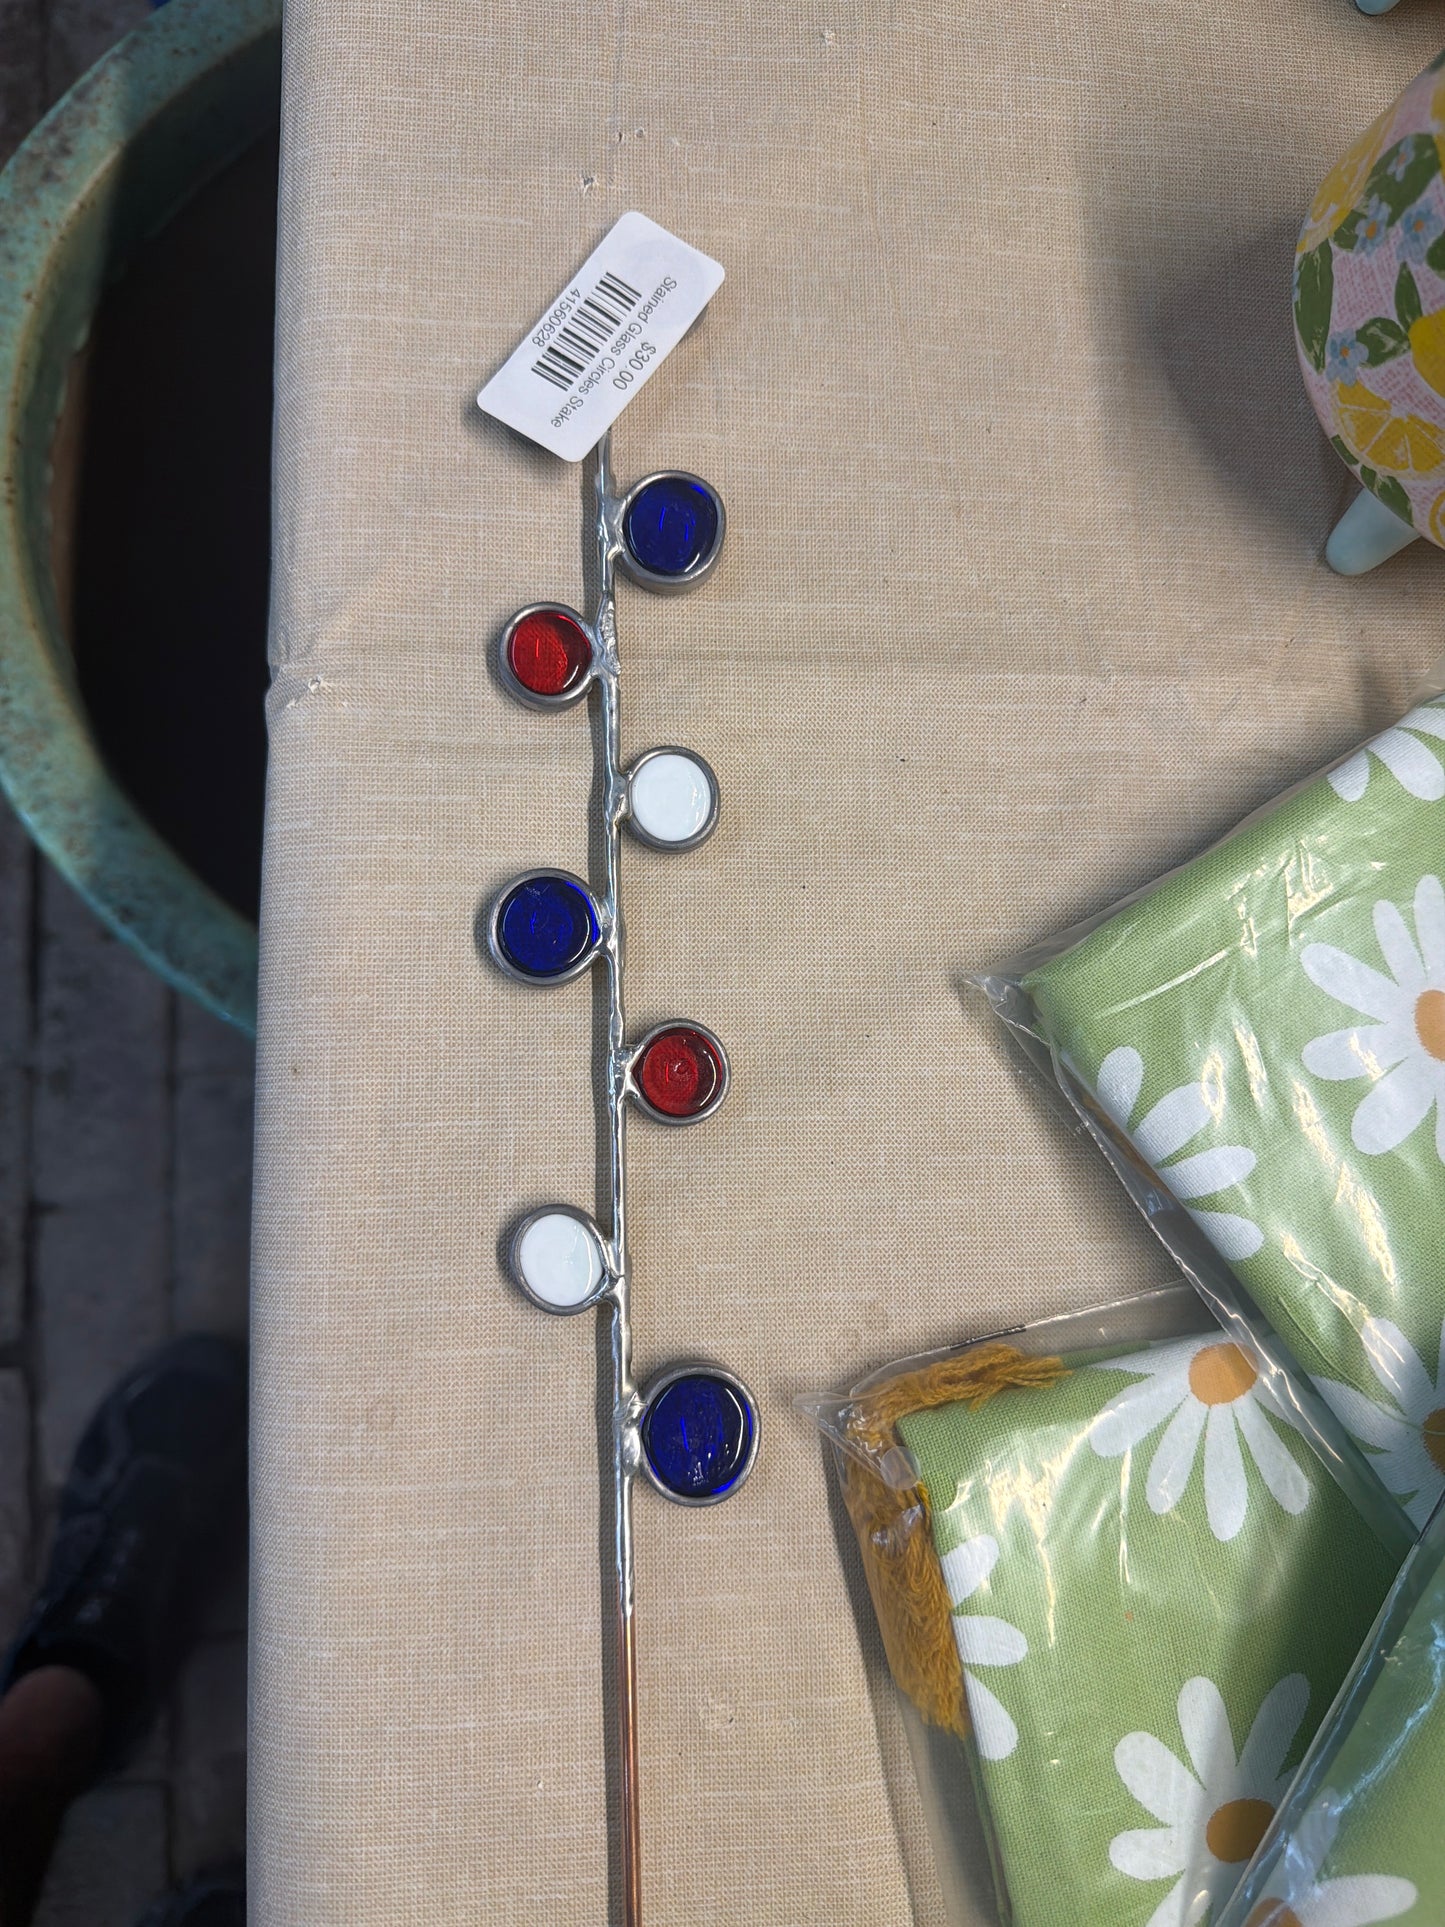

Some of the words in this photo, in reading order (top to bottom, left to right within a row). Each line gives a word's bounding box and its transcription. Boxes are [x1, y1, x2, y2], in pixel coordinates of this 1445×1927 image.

[531, 288, 581, 348] 41560628
[637, 276, 678, 324] Stained
[610, 323, 643, 356] Glass
[578, 358, 616, 395] Circles
[612, 341, 657, 390] $30.00
[550, 395, 584, 428] Stake
